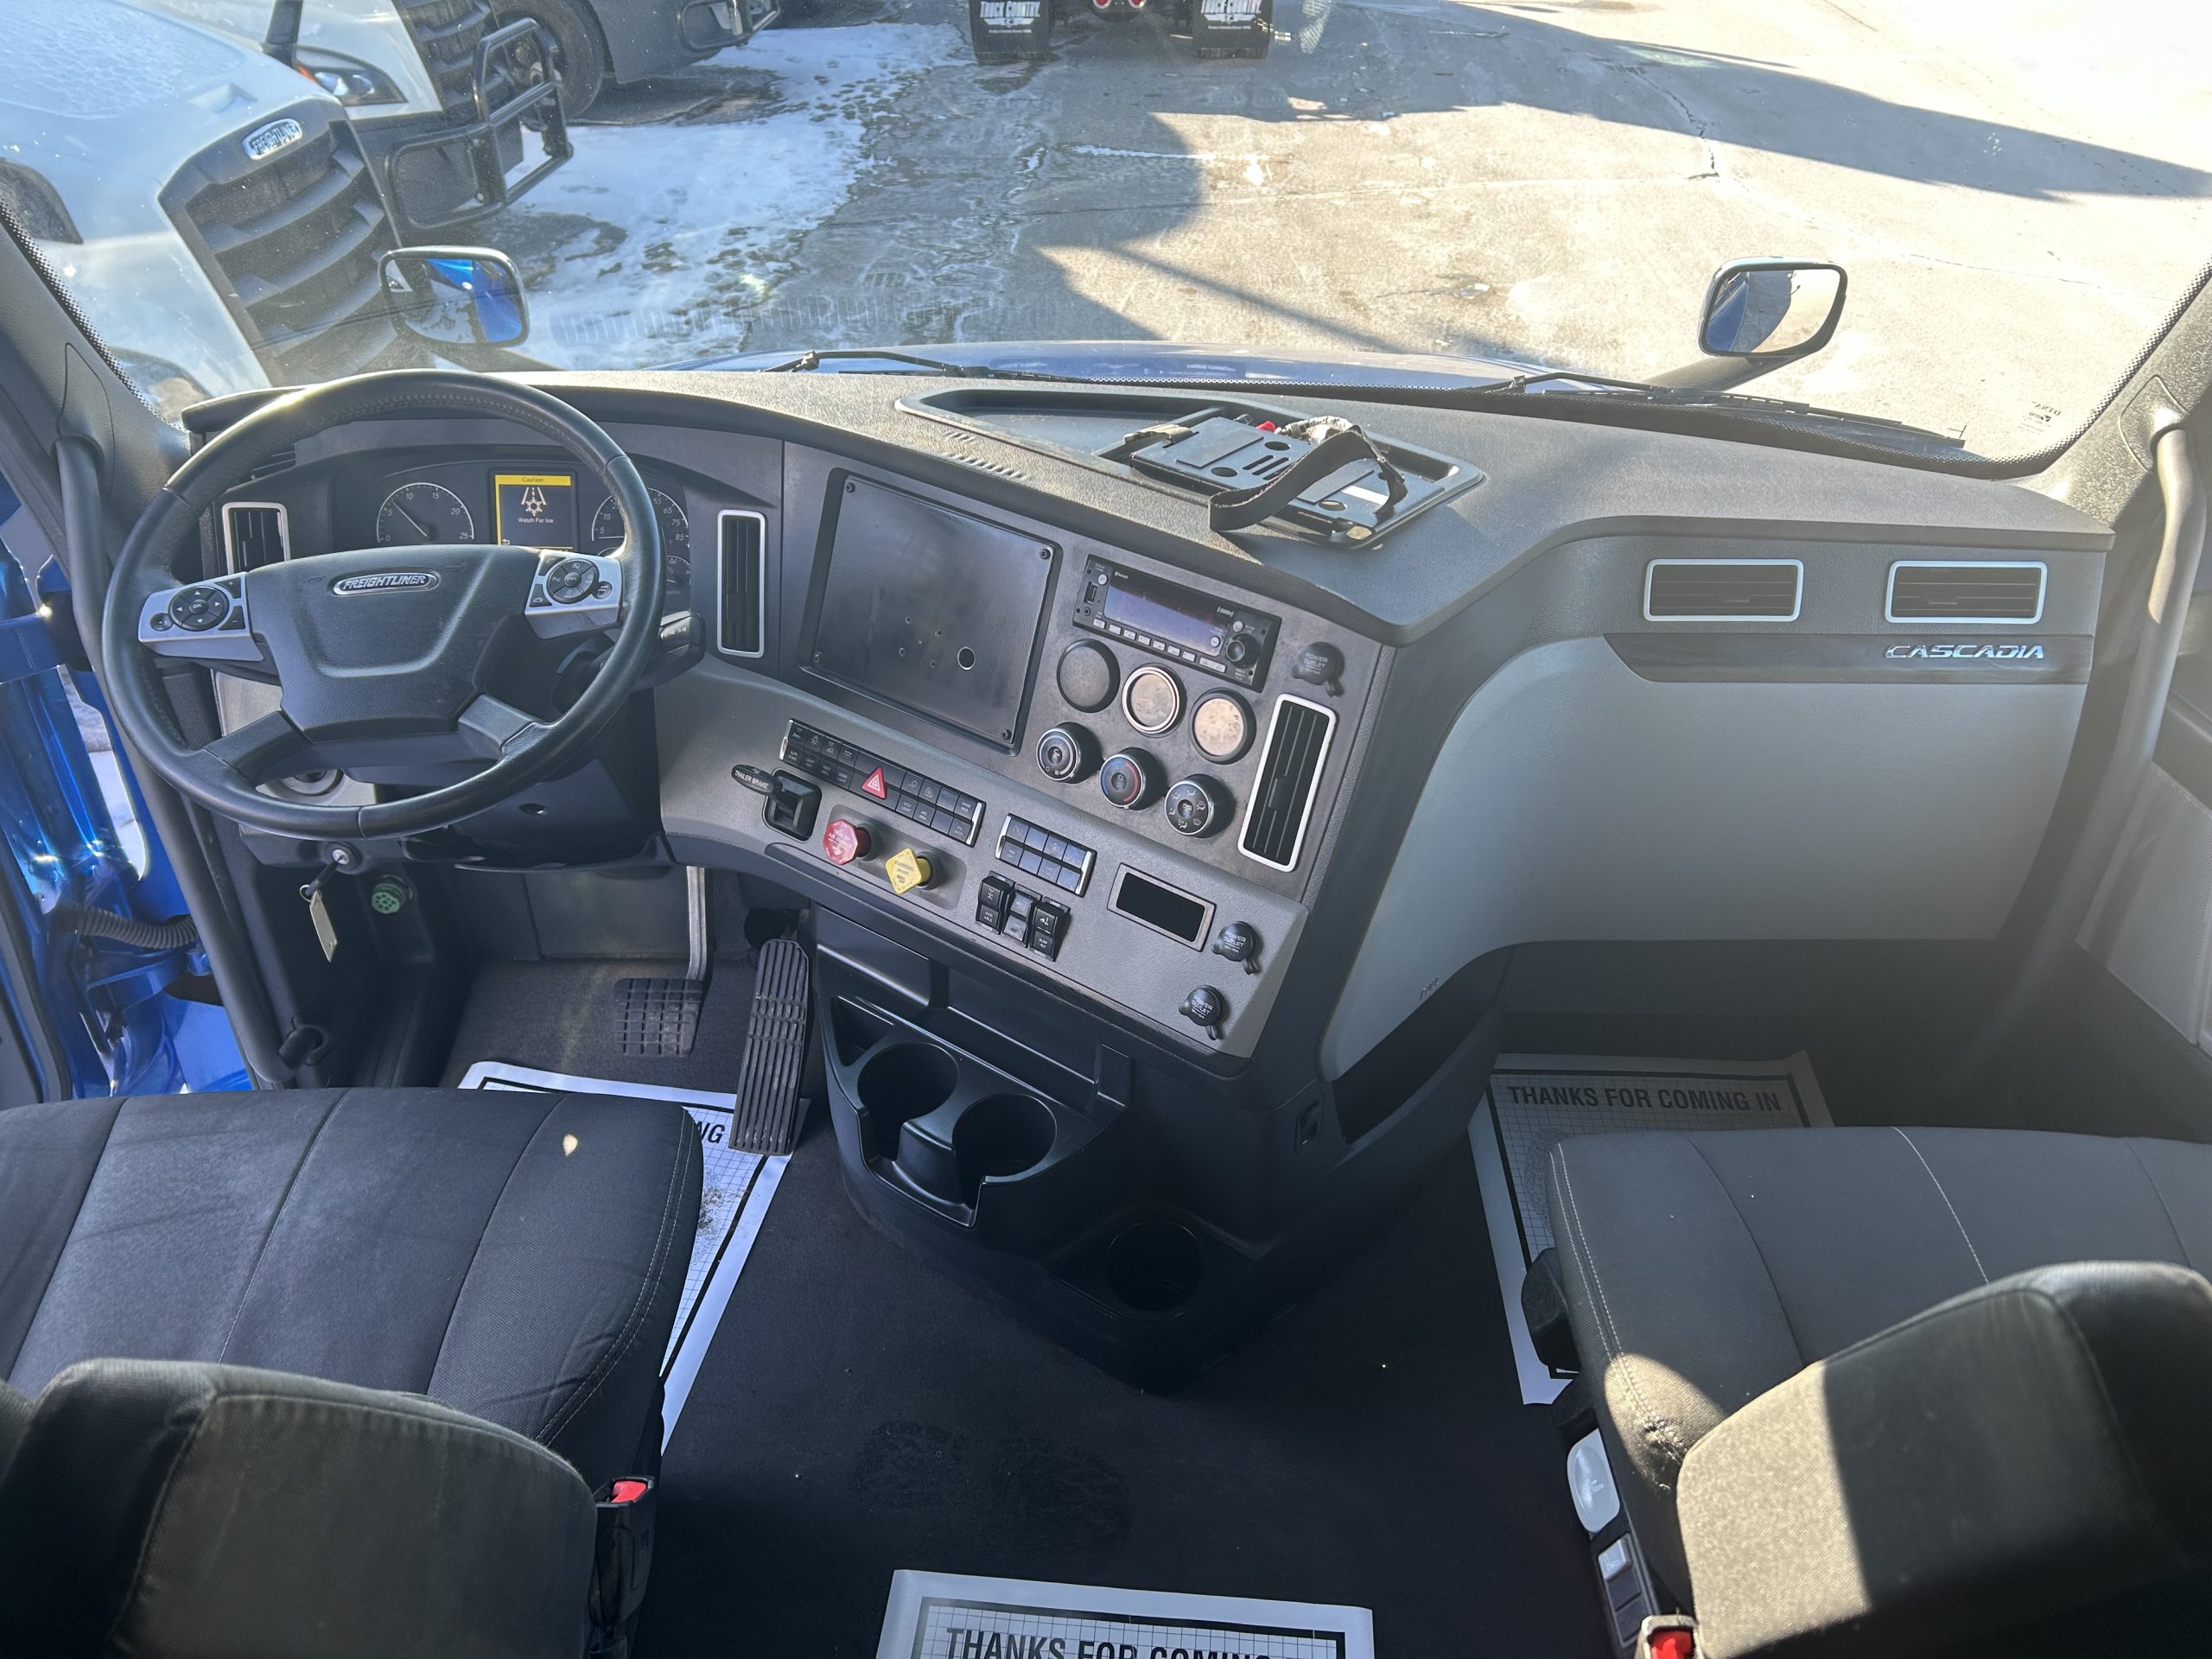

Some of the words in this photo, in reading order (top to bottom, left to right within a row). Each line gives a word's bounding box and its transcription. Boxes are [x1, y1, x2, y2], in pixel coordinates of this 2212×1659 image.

[653, 497, 662, 505] 55
[450, 507, 461, 516] 20
[671, 518, 681, 527] 75
[385, 534, 391, 543] 0
[342, 575, 426, 590] FREIGHTLINER
[1305, 652, 1328, 664] POWER
[1885, 645, 2044, 659] CASCADIA
[1303, 658, 1326, 669] OUTLET
[734, 769, 752, 783] TRAILER
[752, 777, 769, 790] BRAKE
[1223, 936, 1245, 948] OUTLET
[1224, 930, 1247, 944] POWER
[1191, 1000, 1211, 1014] OUTLET
[1193, 995, 1213, 1011] POWER
[1507, 1086, 1599, 1107] THANKS
[1605, 1088, 1652, 1109] FOR
[1658, 1089, 1751, 1111] COMING
[1755, 1092, 1782, 1112] IN
[947, 1628, 1065, 1659] THANKS
